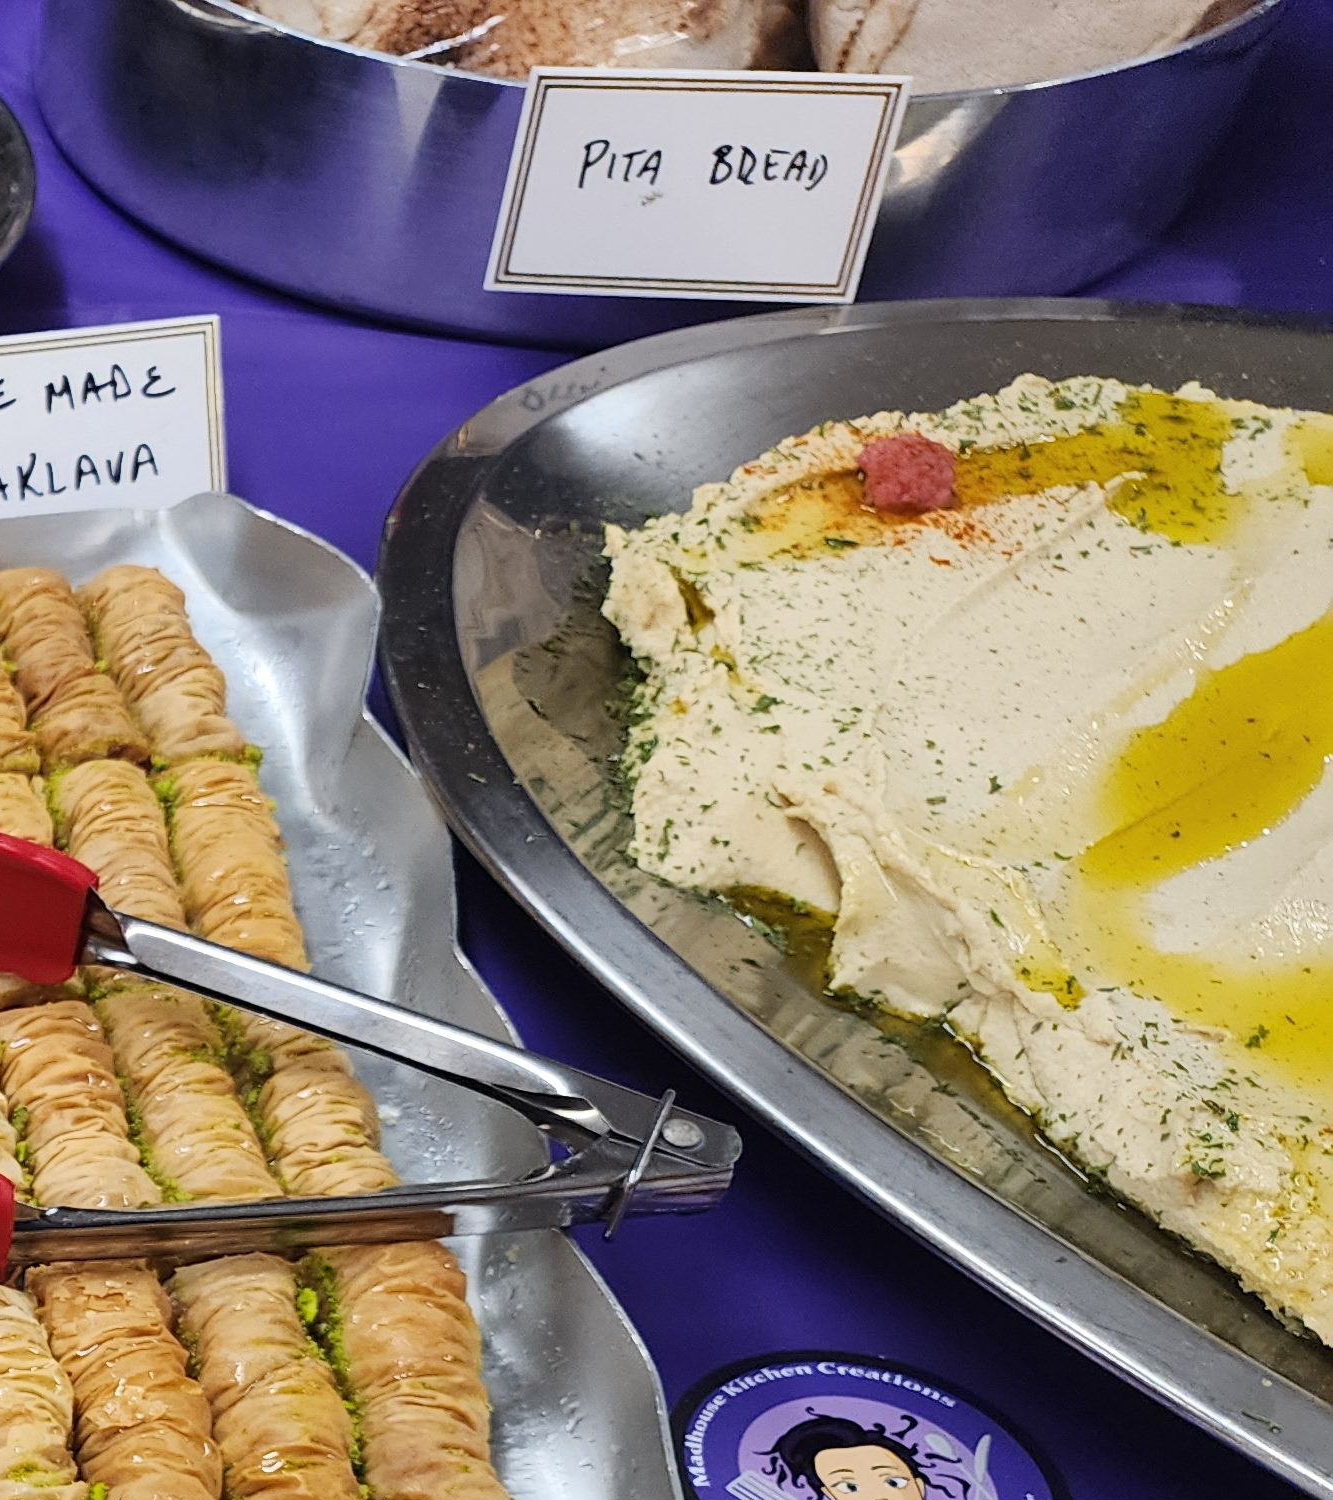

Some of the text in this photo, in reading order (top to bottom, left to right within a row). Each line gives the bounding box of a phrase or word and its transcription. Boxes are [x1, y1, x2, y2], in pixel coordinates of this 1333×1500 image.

[578, 139, 829, 191] PITA BREAD
[43, 363, 177, 414] MADE
[683, 1360, 957, 1488] Madhouse Kitchen Creations
